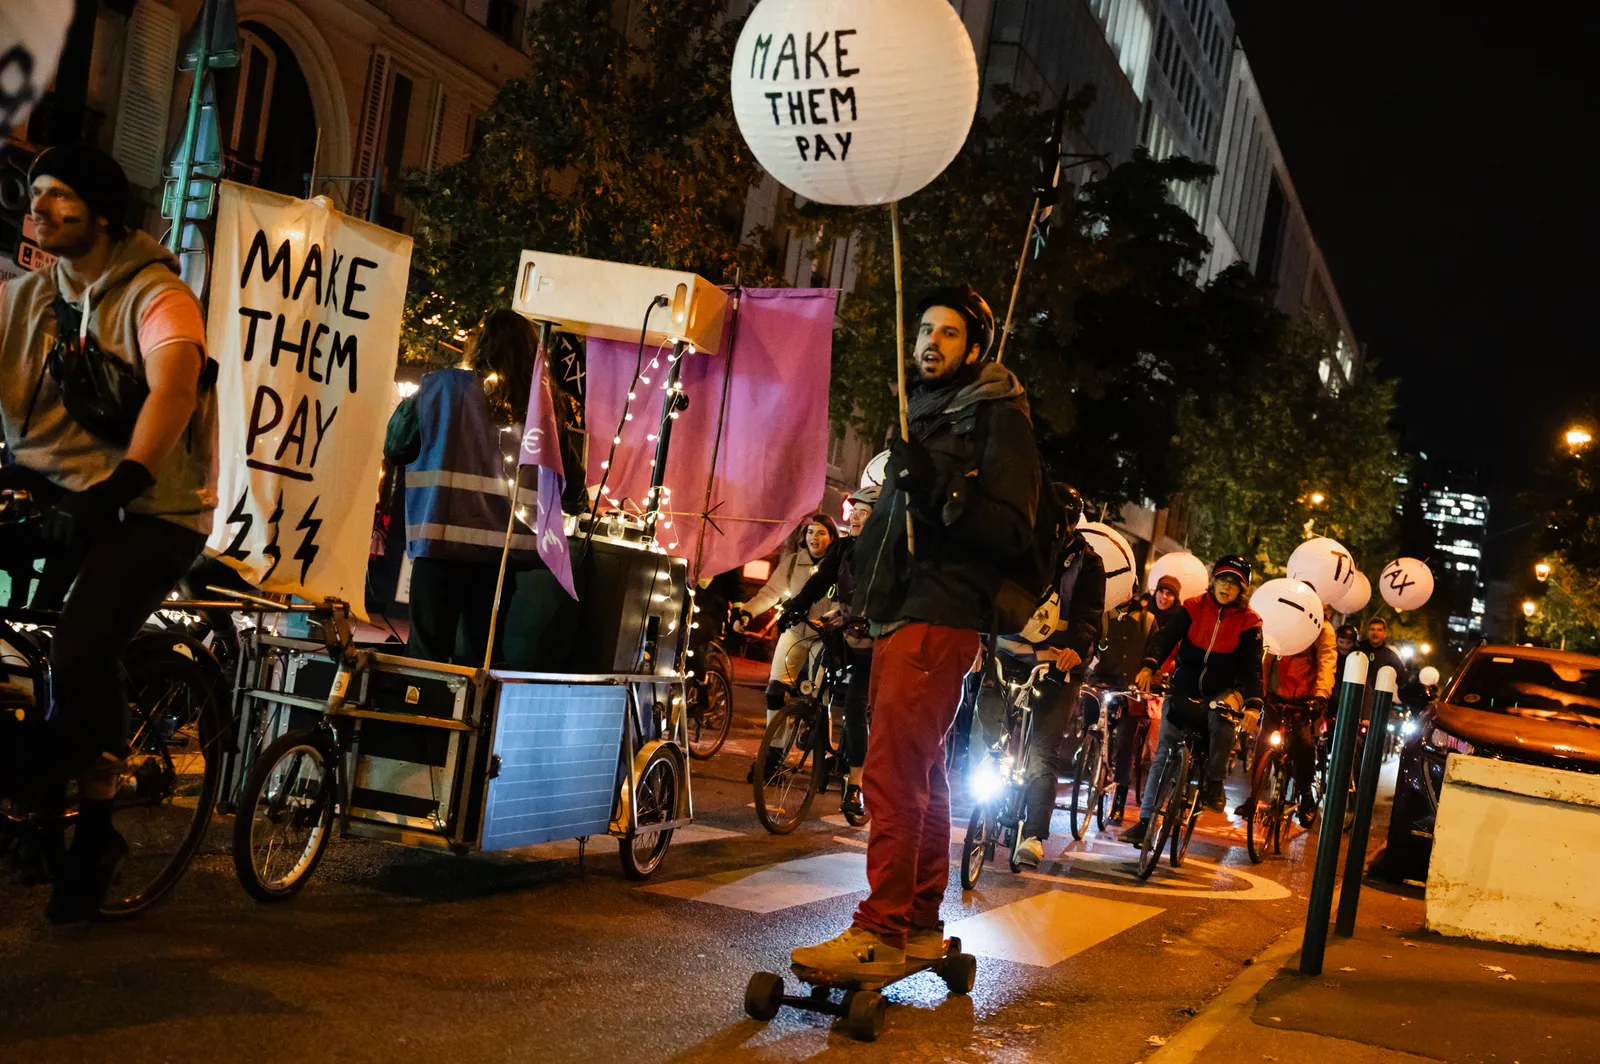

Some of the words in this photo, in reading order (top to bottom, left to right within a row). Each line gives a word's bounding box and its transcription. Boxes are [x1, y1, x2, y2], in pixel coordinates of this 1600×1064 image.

[751, 29, 860, 81] MAKE
[764, 87, 858, 126] THEM
[795, 131, 852, 162] PAY
[240, 229, 379, 320] MAKE
[238, 306, 358, 393] THEM
[560, 338, 586, 395] TAX
[246, 385, 338, 468] PAY
[1382, 560, 1415, 596] TAX
